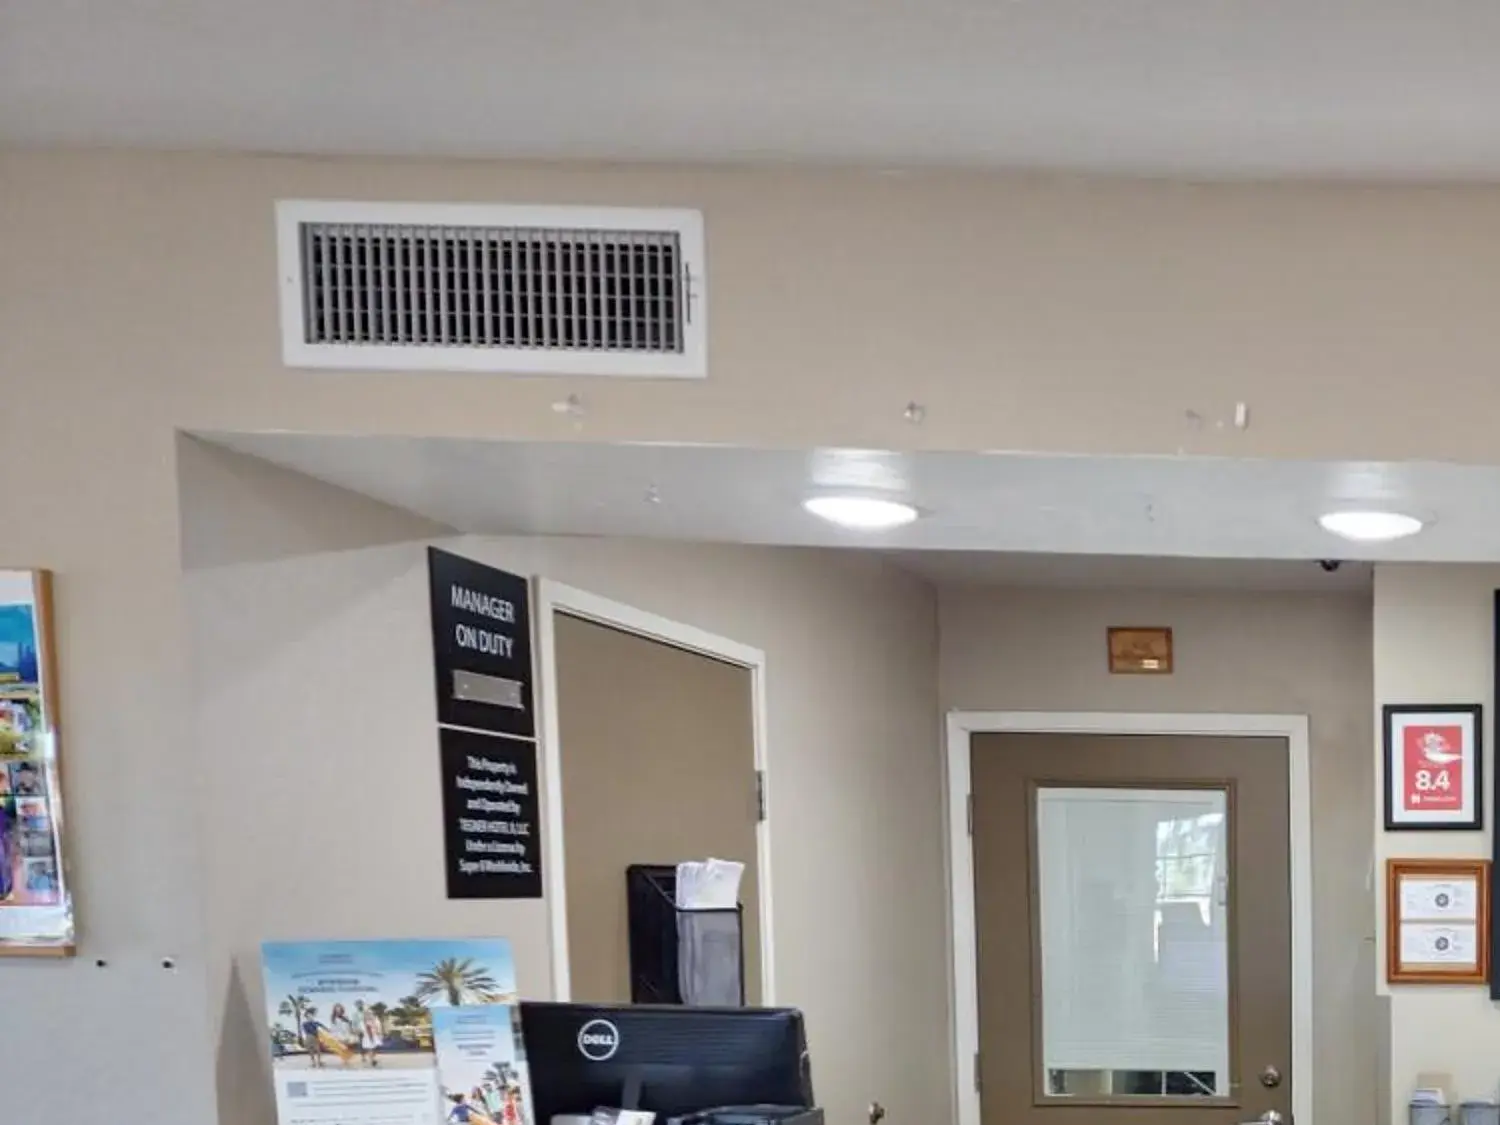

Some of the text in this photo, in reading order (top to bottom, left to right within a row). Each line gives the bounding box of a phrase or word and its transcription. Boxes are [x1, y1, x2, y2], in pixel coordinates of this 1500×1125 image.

[451, 584, 515, 624] MANAGER
[455, 623, 513, 659] ON DUTY
[1414, 769, 1451, 791] 8.4
[583, 1033, 614, 1045] DELL
